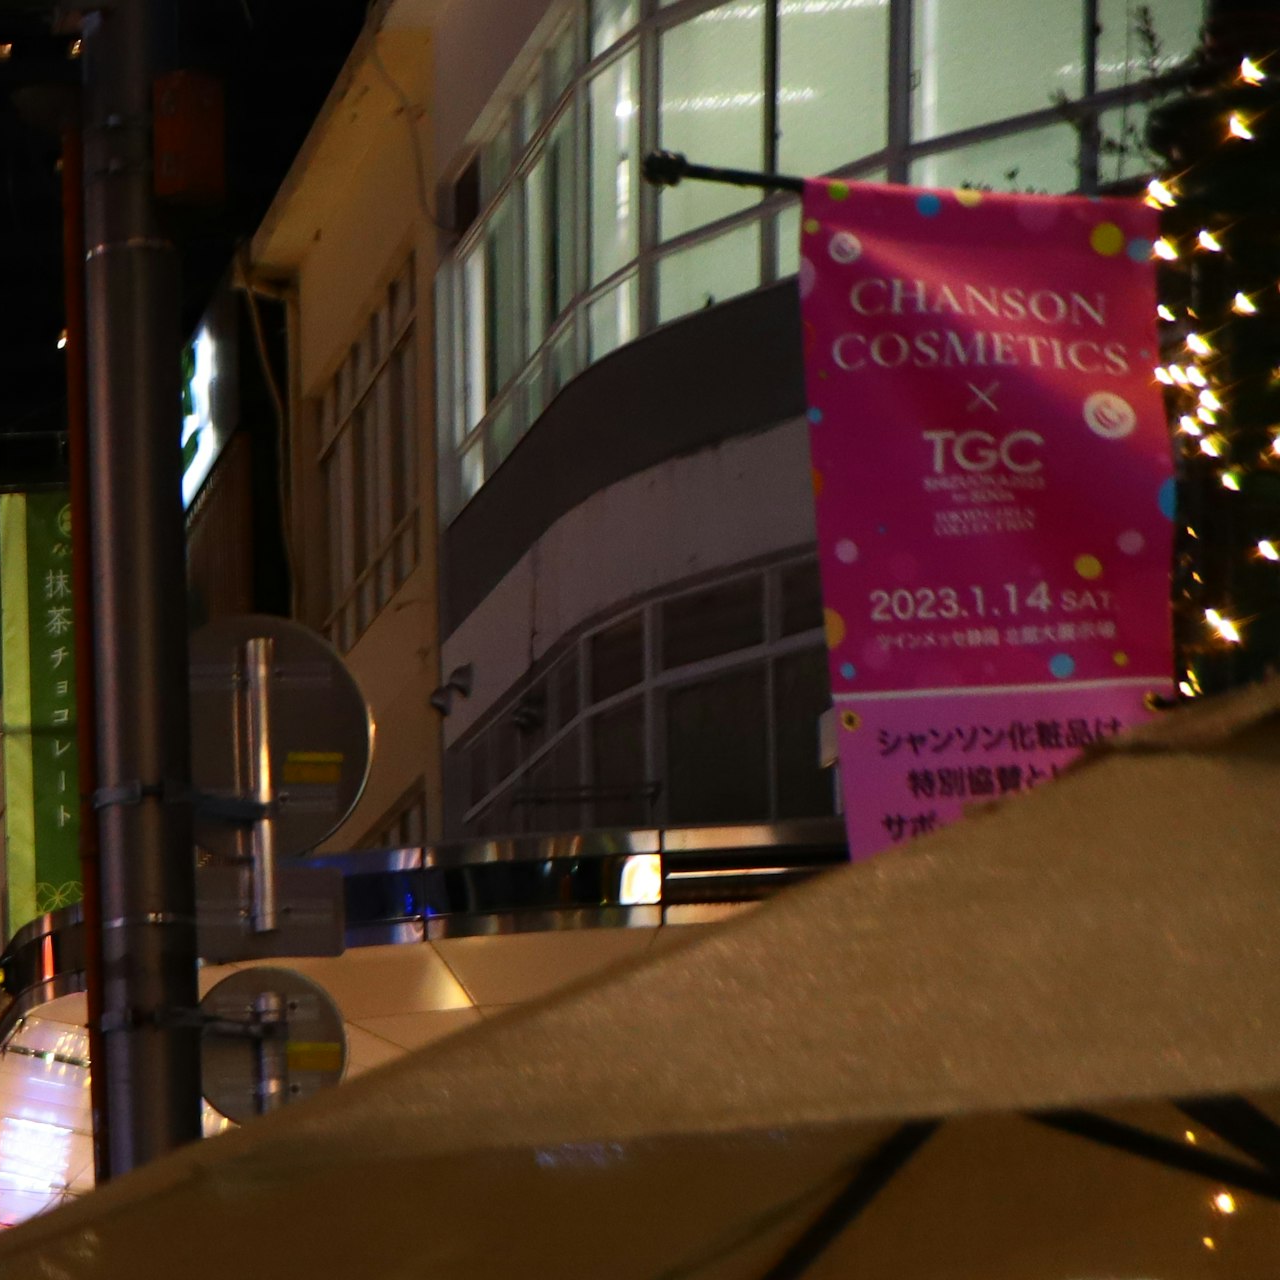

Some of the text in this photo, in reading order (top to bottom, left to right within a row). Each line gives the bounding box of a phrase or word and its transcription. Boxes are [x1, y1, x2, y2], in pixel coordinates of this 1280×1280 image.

[848, 278, 1107, 328] CHANSON
[831, 330, 1130, 376] COSMETICS
[921, 428, 1046, 475] TGC
[868, 581, 1053, 623] 2023.1.14
[44, 568, 74, 830] 抹茶チョコレート
